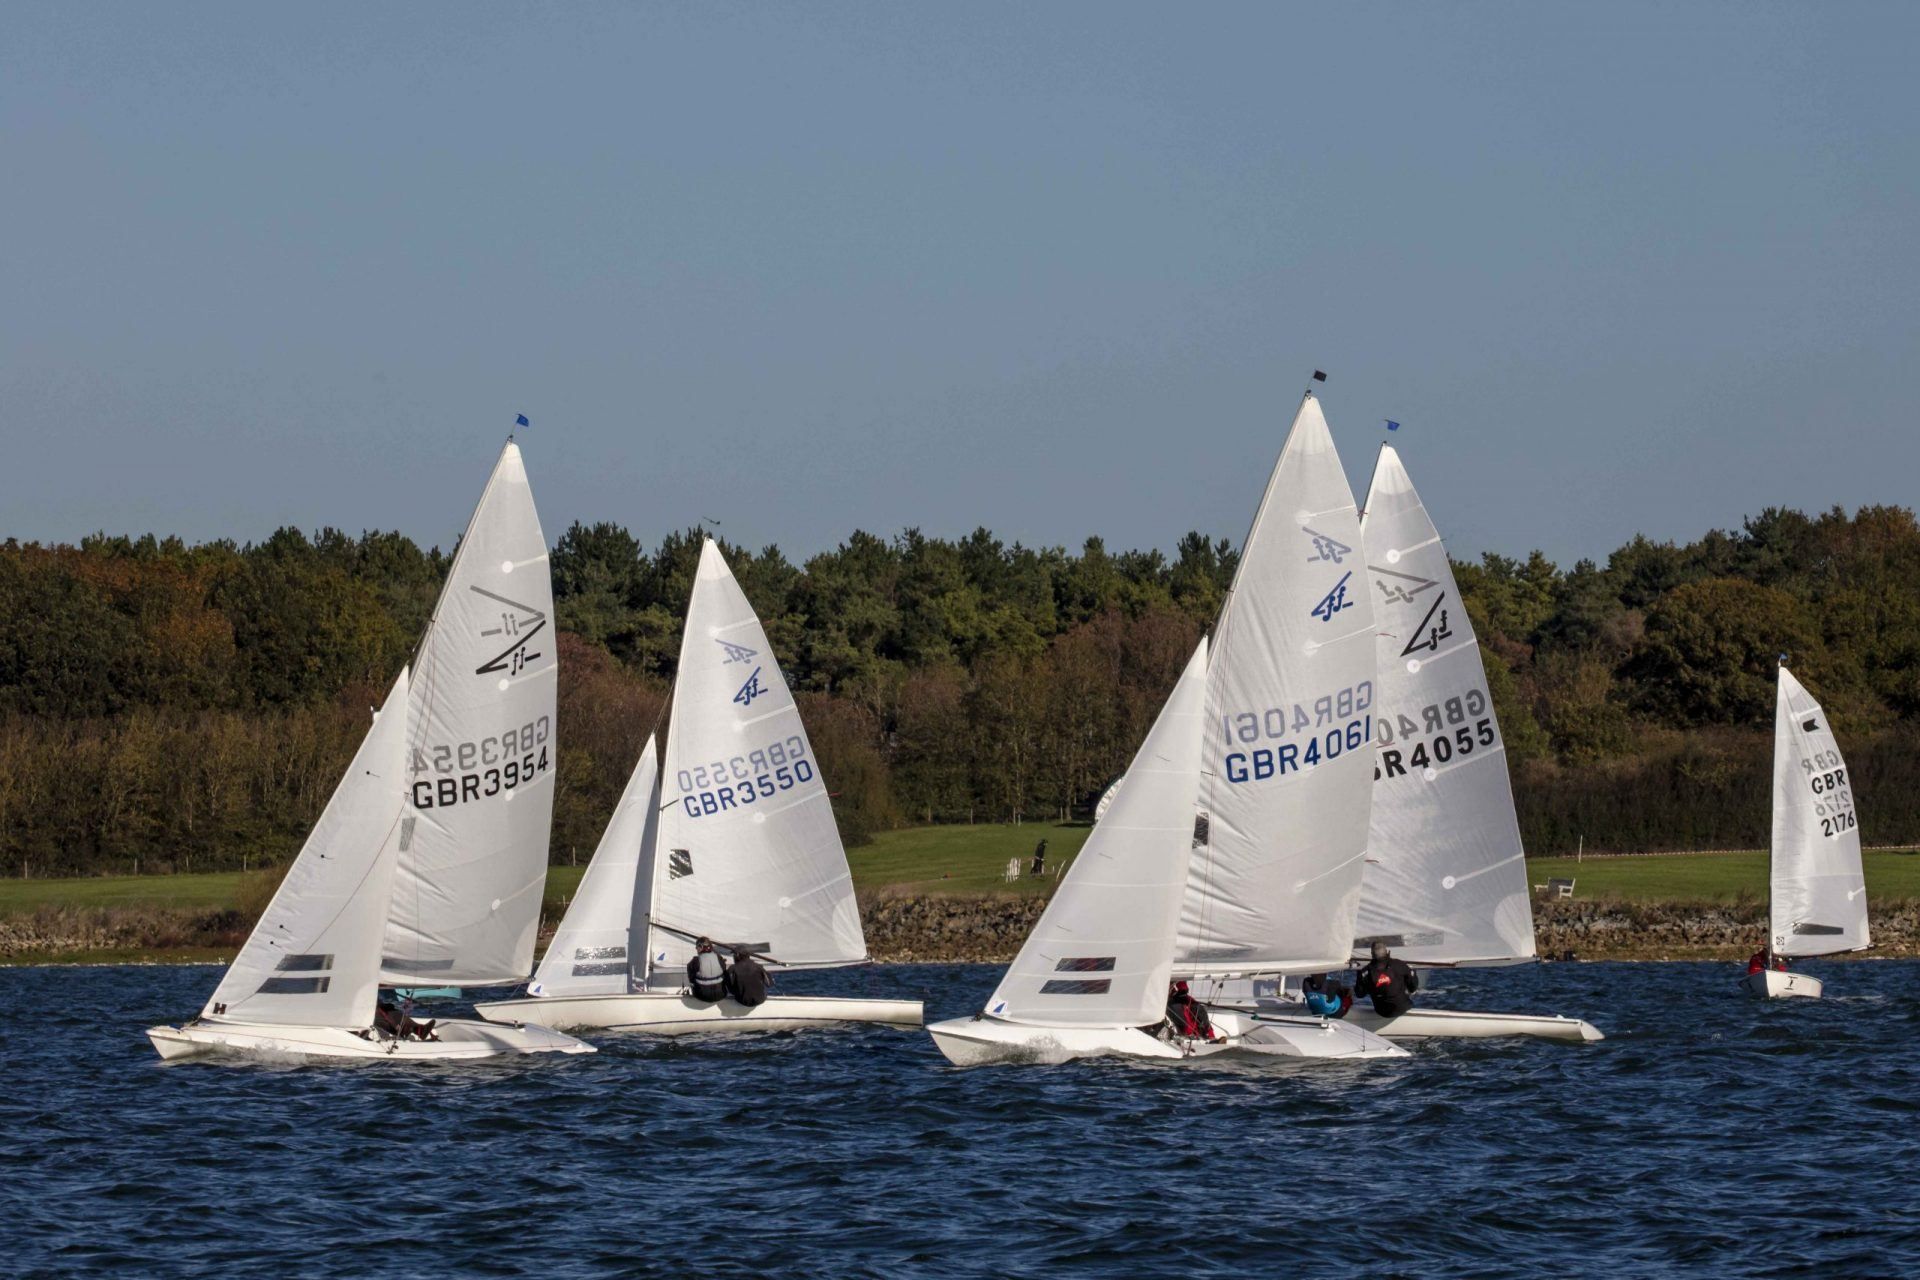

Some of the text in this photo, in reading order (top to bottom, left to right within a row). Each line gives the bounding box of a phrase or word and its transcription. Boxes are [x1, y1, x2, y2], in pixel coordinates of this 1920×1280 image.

[412, 745, 549, 810] GBR3954
[1225, 714, 1371, 784] GBR4061
[684, 759, 813, 818] GBR3550
[1811, 769, 1846, 794] GBR
[1820, 811, 1855, 837] 2176
